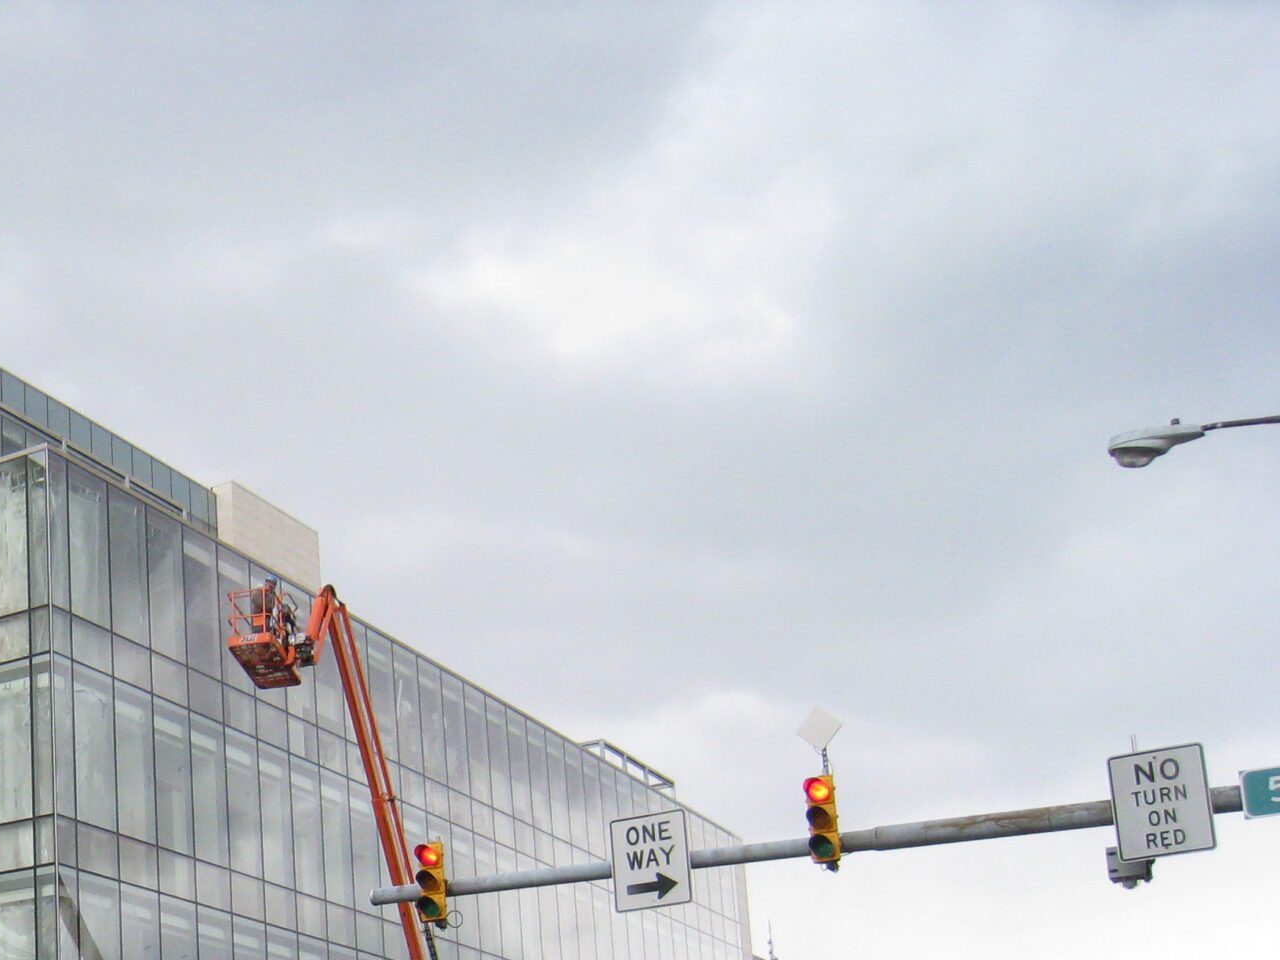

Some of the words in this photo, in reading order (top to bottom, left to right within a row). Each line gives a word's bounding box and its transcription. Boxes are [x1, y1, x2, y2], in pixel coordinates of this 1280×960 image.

[1134, 758, 1180, 785] NO
[1131, 784, 1187, 807] TURN
[1148, 808, 1177, 827] ON
[626, 821, 672, 846] ONE
[1146, 829, 1186, 849] RED
[626, 844, 675, 871] WAY
